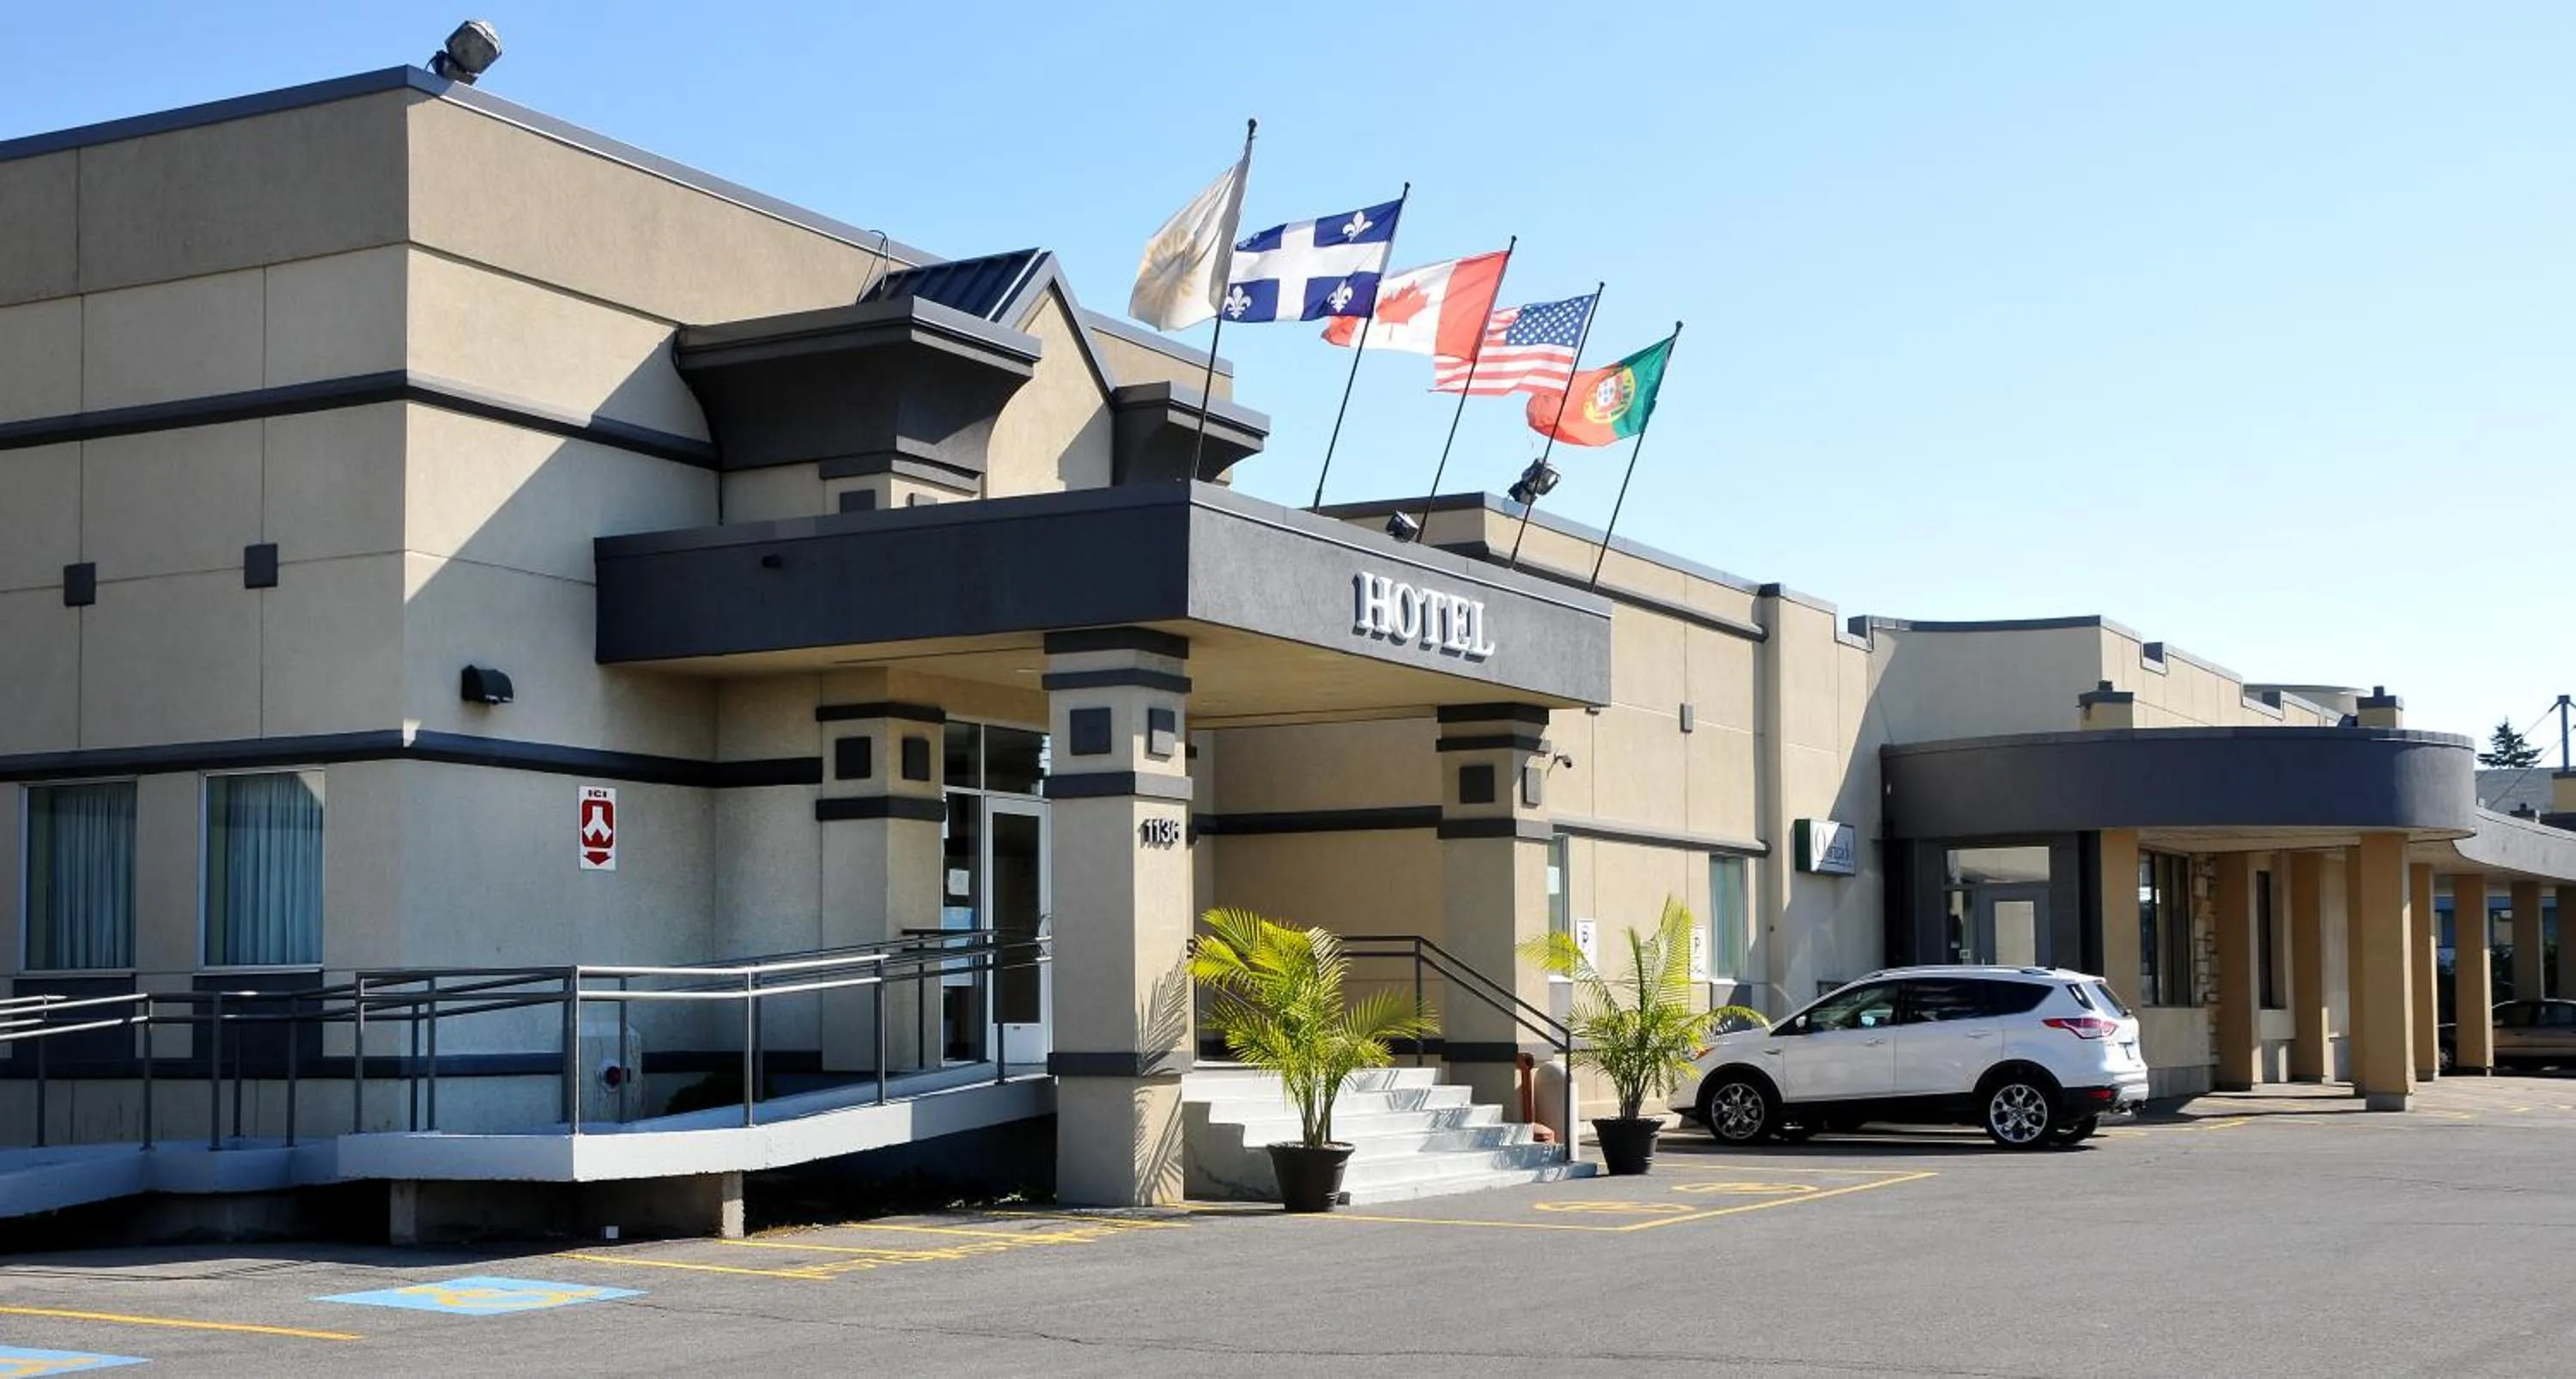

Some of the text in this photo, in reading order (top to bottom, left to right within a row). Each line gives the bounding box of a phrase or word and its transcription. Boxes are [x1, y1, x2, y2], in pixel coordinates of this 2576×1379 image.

[1354, 571, 1496, 657] HOTEL
[588, 789, 607, 798] ICI
[1141, 818, 1181, 843] 1136
